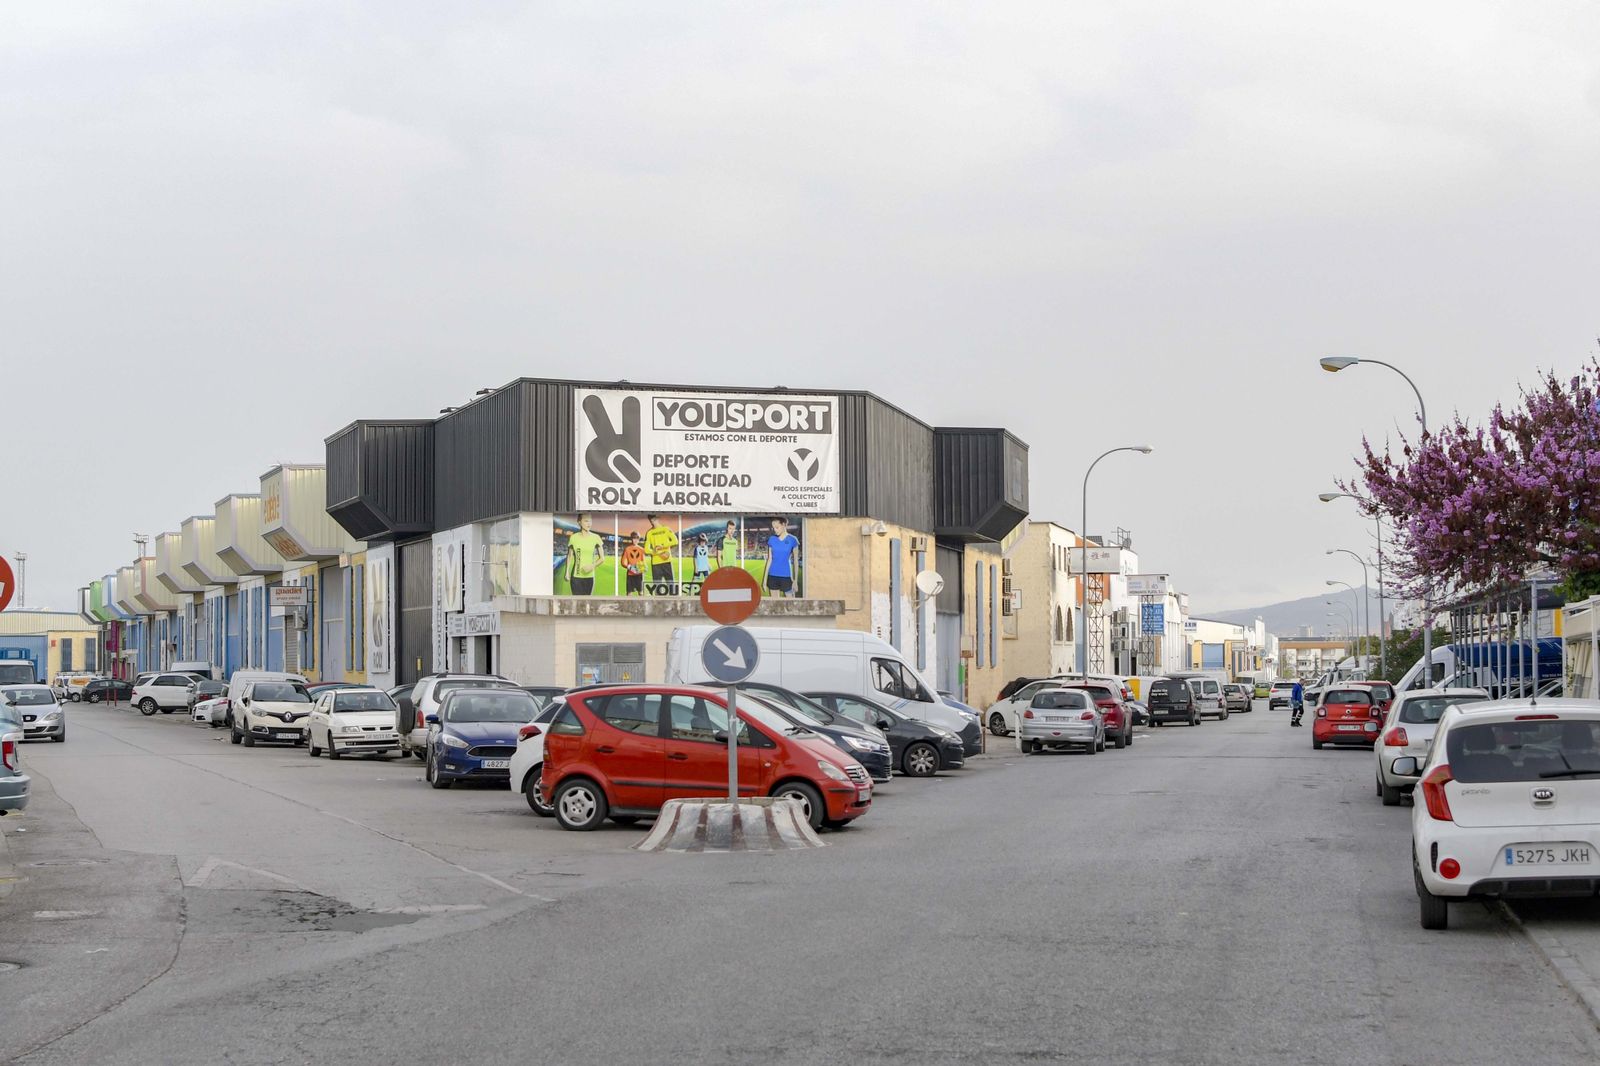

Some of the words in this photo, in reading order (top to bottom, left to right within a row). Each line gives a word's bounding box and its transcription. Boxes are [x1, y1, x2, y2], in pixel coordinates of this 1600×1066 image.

[656, 400, 830, 431] YOUSPORT
[684, 433, 725, 442] ESTAMOS
[727, 434, 747, 443] CON
[749, 434, 758, 443] EL
[759, 435, 798, 444] DEPORTE
[653, 453, 730, 469] DEPORTE
[653, 472, 752, 488] PUBLICIDAD
[587, 486, 642, 505] ROLY
[773, 485, 799, 493] PRECIOS
[653, 491, 732, 507] LABORAL
[645, 582, 702, 597] YOUSP
[486, 760, 504, 768] 4827
[1516, 849, 1556, 864] 5275
[1560, 848, 1590, 863] JKH
